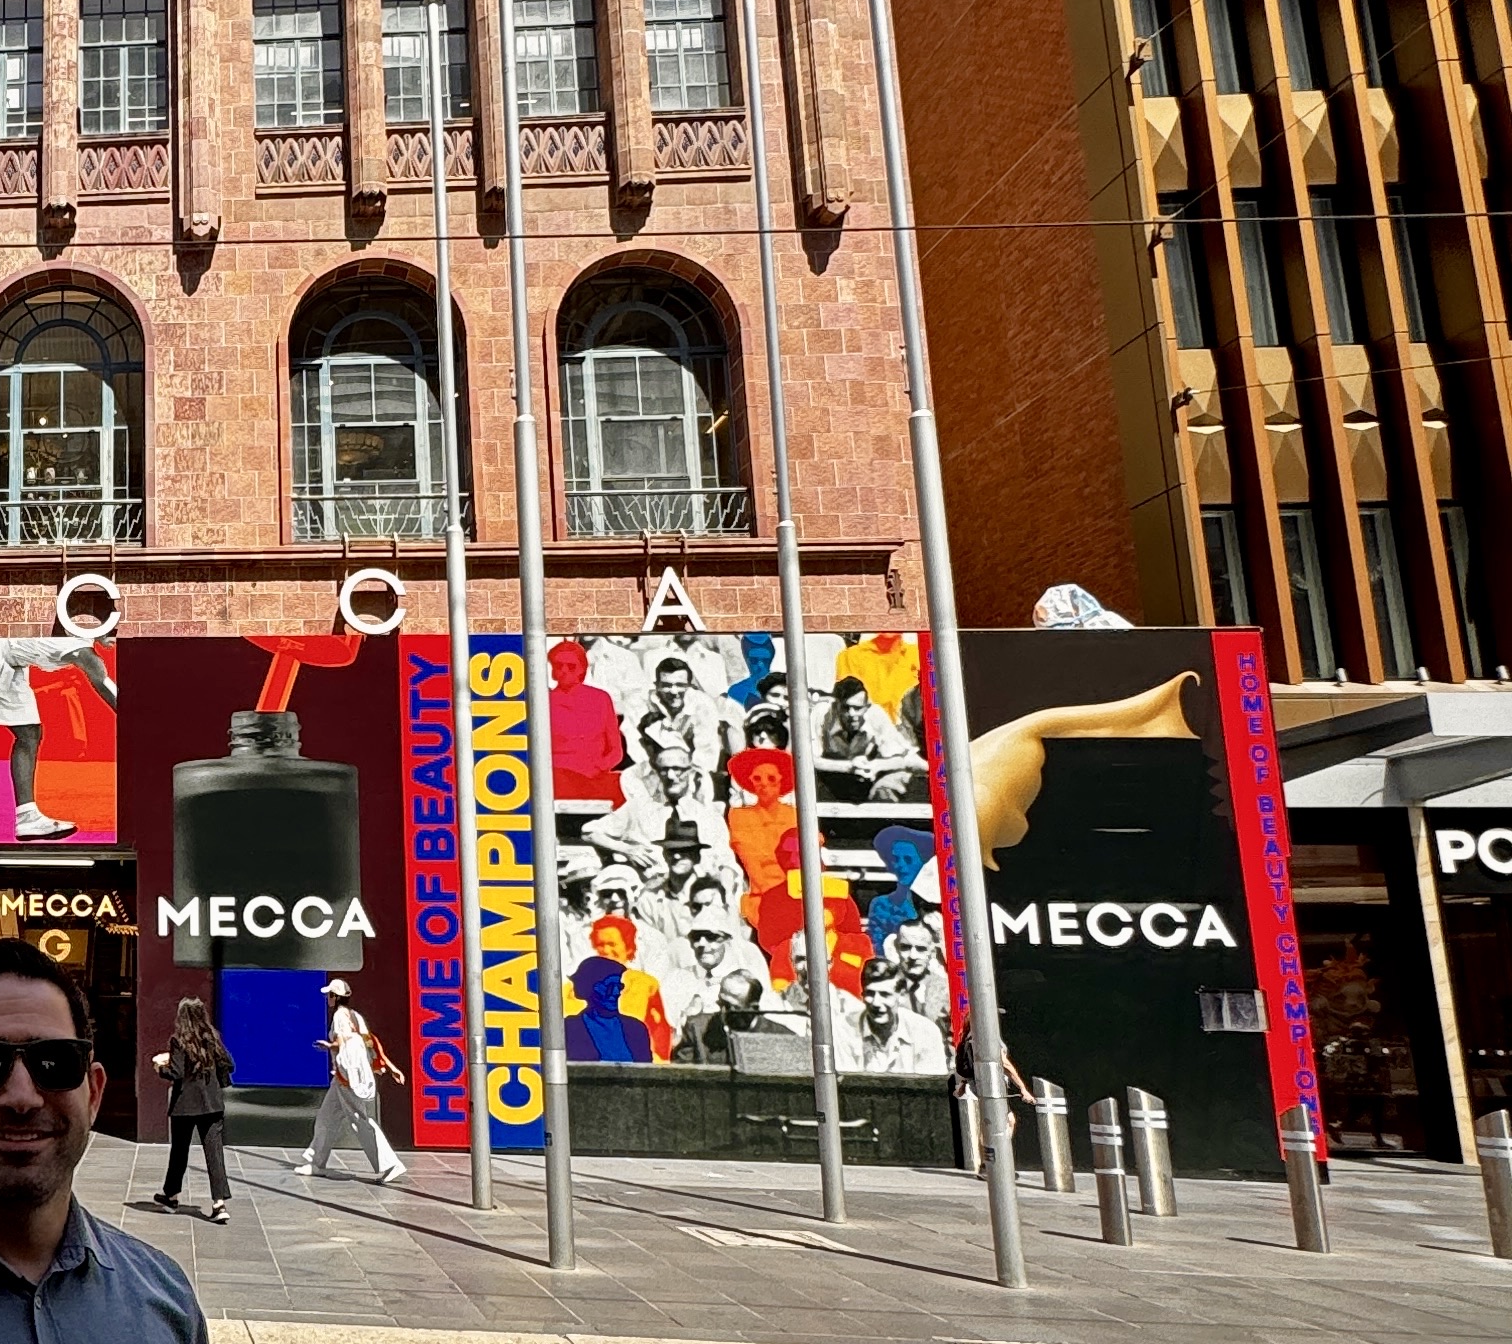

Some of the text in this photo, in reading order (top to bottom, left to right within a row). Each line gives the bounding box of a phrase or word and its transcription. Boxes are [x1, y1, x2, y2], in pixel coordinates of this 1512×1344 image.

[1238, 652, 1265, 735] HOME
[1249, 743, 1271, 785] OF
[407, 652, 467, 1123] HOME OF BEAUTY
[468, 652, 545, 1125] CHAMPIONS
[1257, 795, 1289, 924] BEAUTY
[1, 893, 117, 918] MECCA
[157, 895, 377, 939] MECCA
[990, 902, 1238, 948] MECCA
